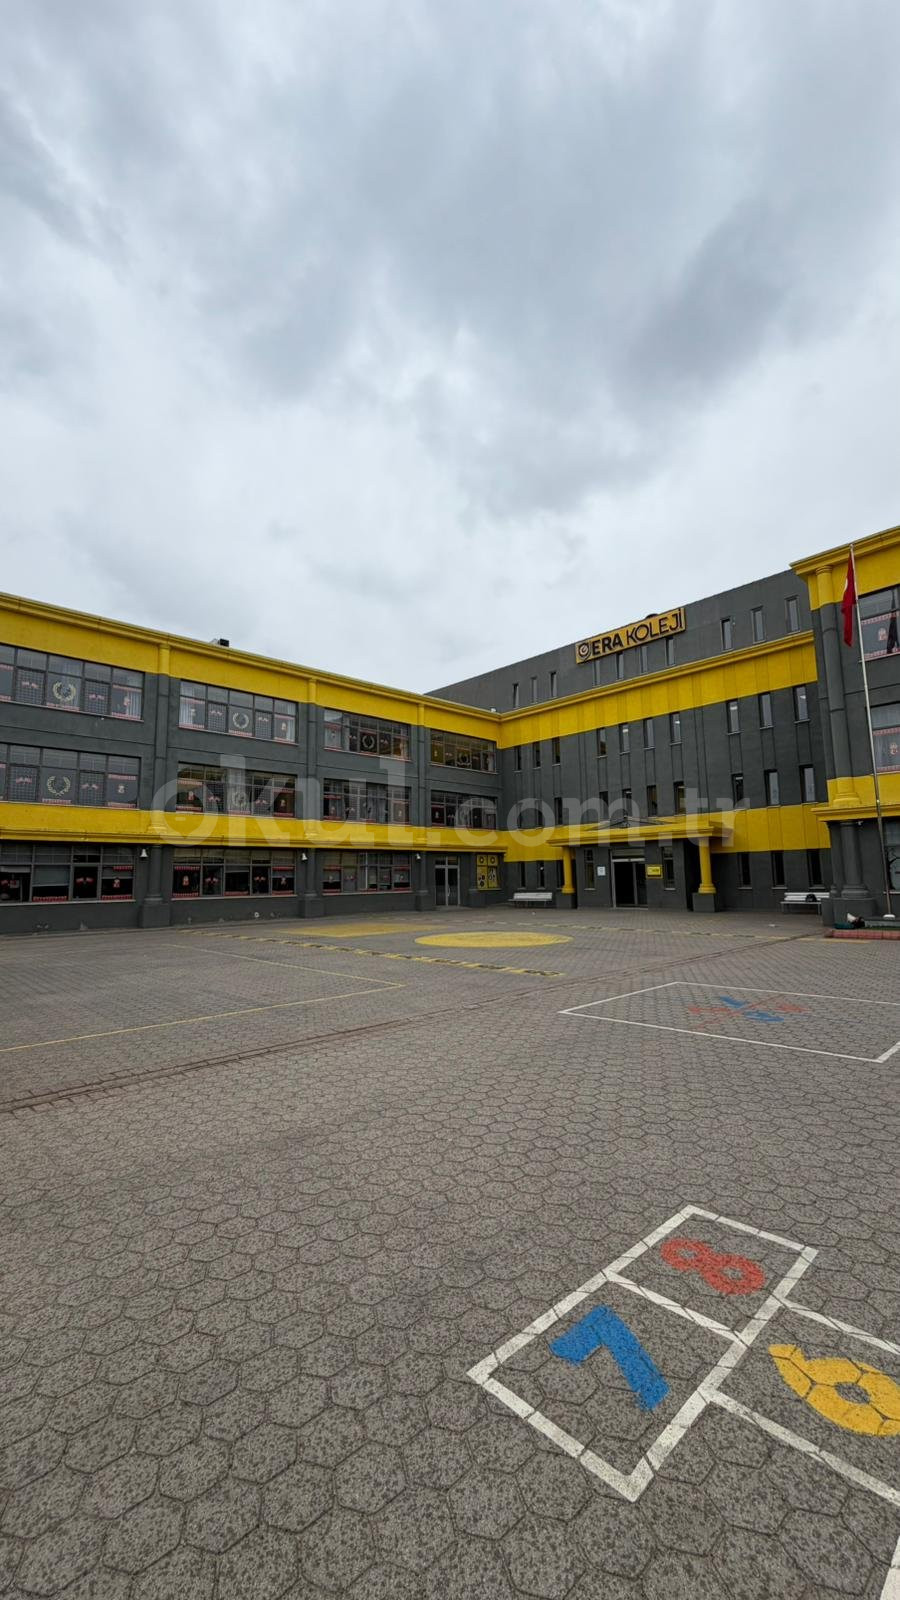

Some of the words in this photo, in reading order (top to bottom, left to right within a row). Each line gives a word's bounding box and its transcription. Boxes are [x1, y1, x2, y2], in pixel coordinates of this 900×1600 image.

[592, 633, 624, 656] ERA
[660, 1237, 765, 1296] 8
[549, 1304, 670, 1412] 7
[768, 1343, 900, 1437] 6
